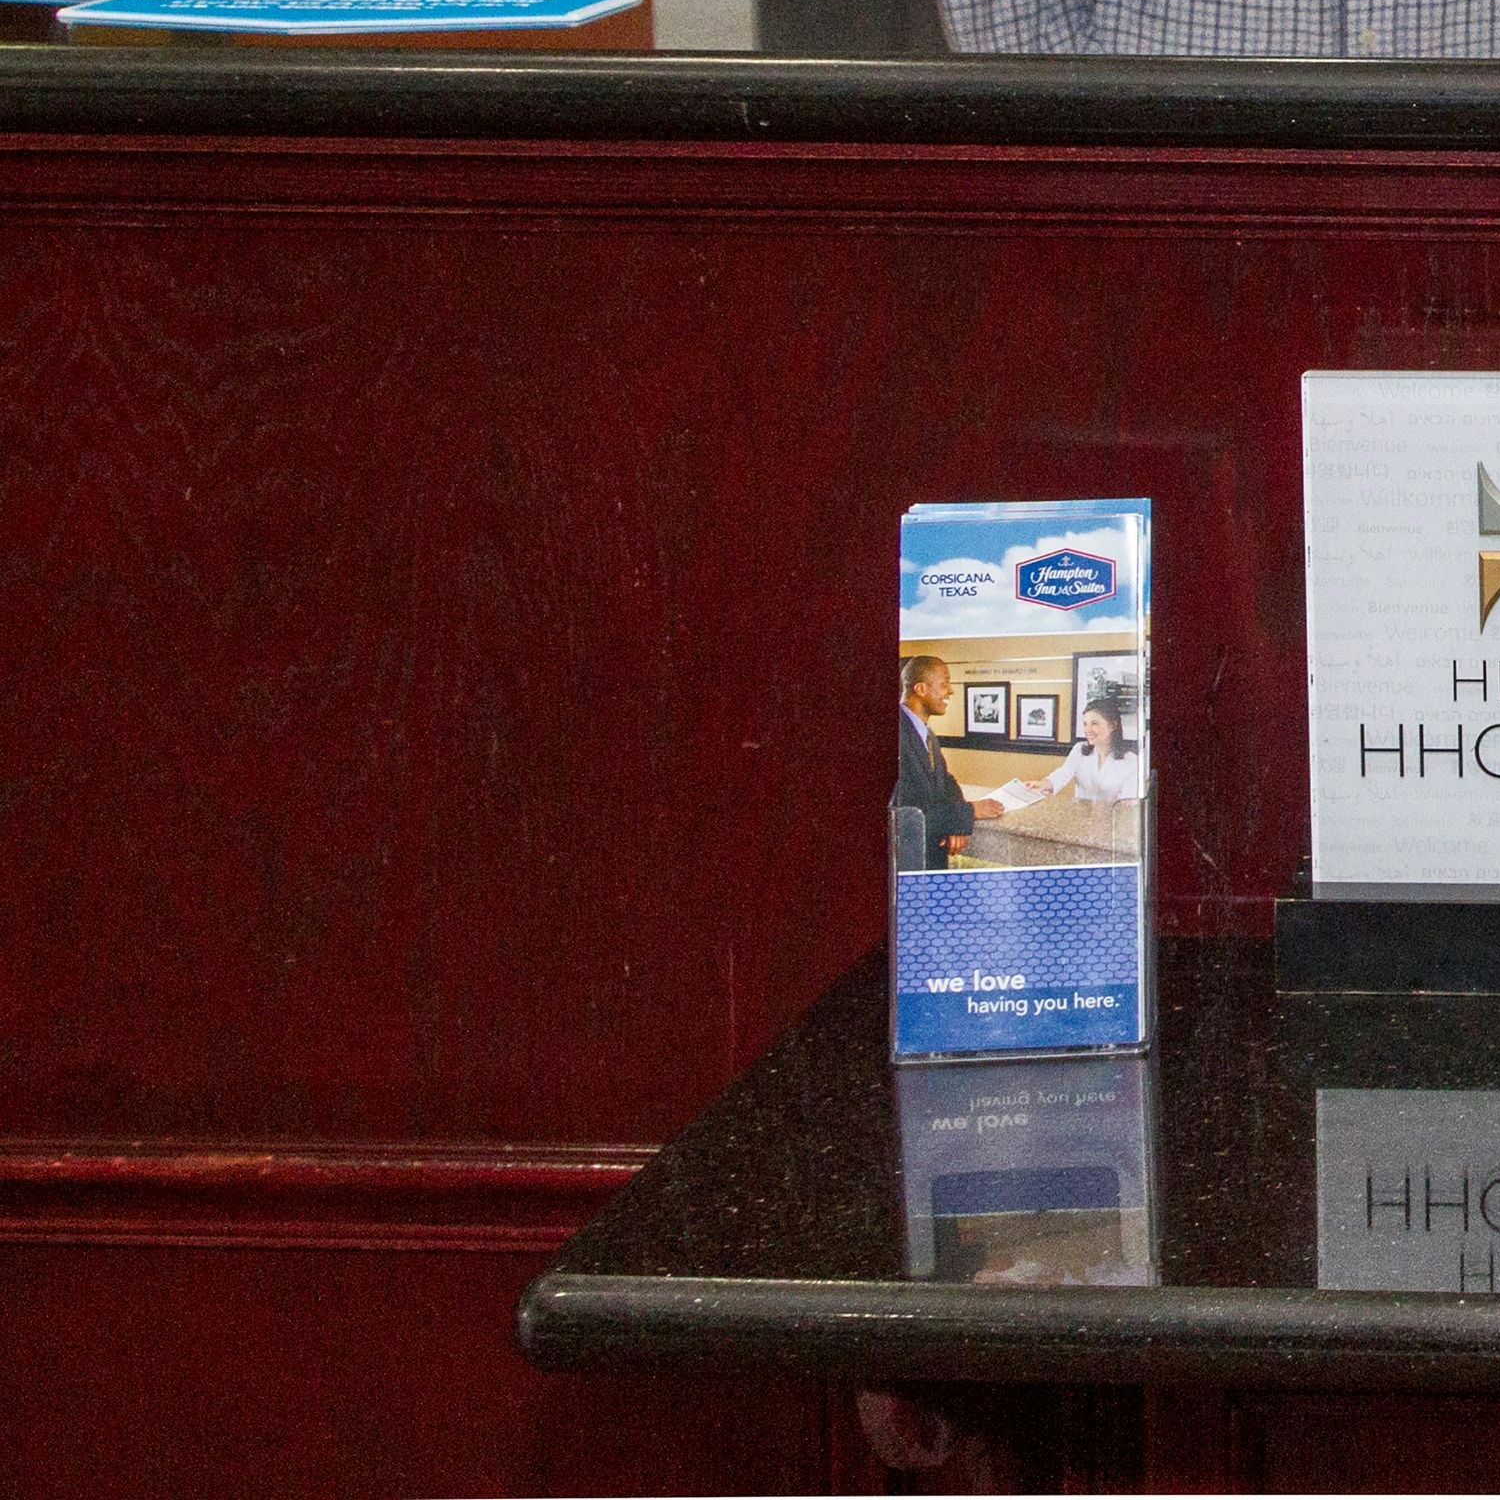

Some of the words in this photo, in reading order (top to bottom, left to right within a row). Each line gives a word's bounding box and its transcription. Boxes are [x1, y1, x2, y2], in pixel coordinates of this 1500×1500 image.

[921, 572, 995, 586] CORSICANA,
[1030, 565, 1099, 584] Hampton
[939, 586, 978, 597] TEXAS
[1027, 584, 1063, 597] Inn
[1069, 582, 1106, 596] Suites
[927, 975, 965, 994] we
[973, 969, 1026, 992] love
[967, 997, 1028, 1016] having
[1033, 997, 1068, 1016] you
[1073, 991, 1121, 1010] here.
